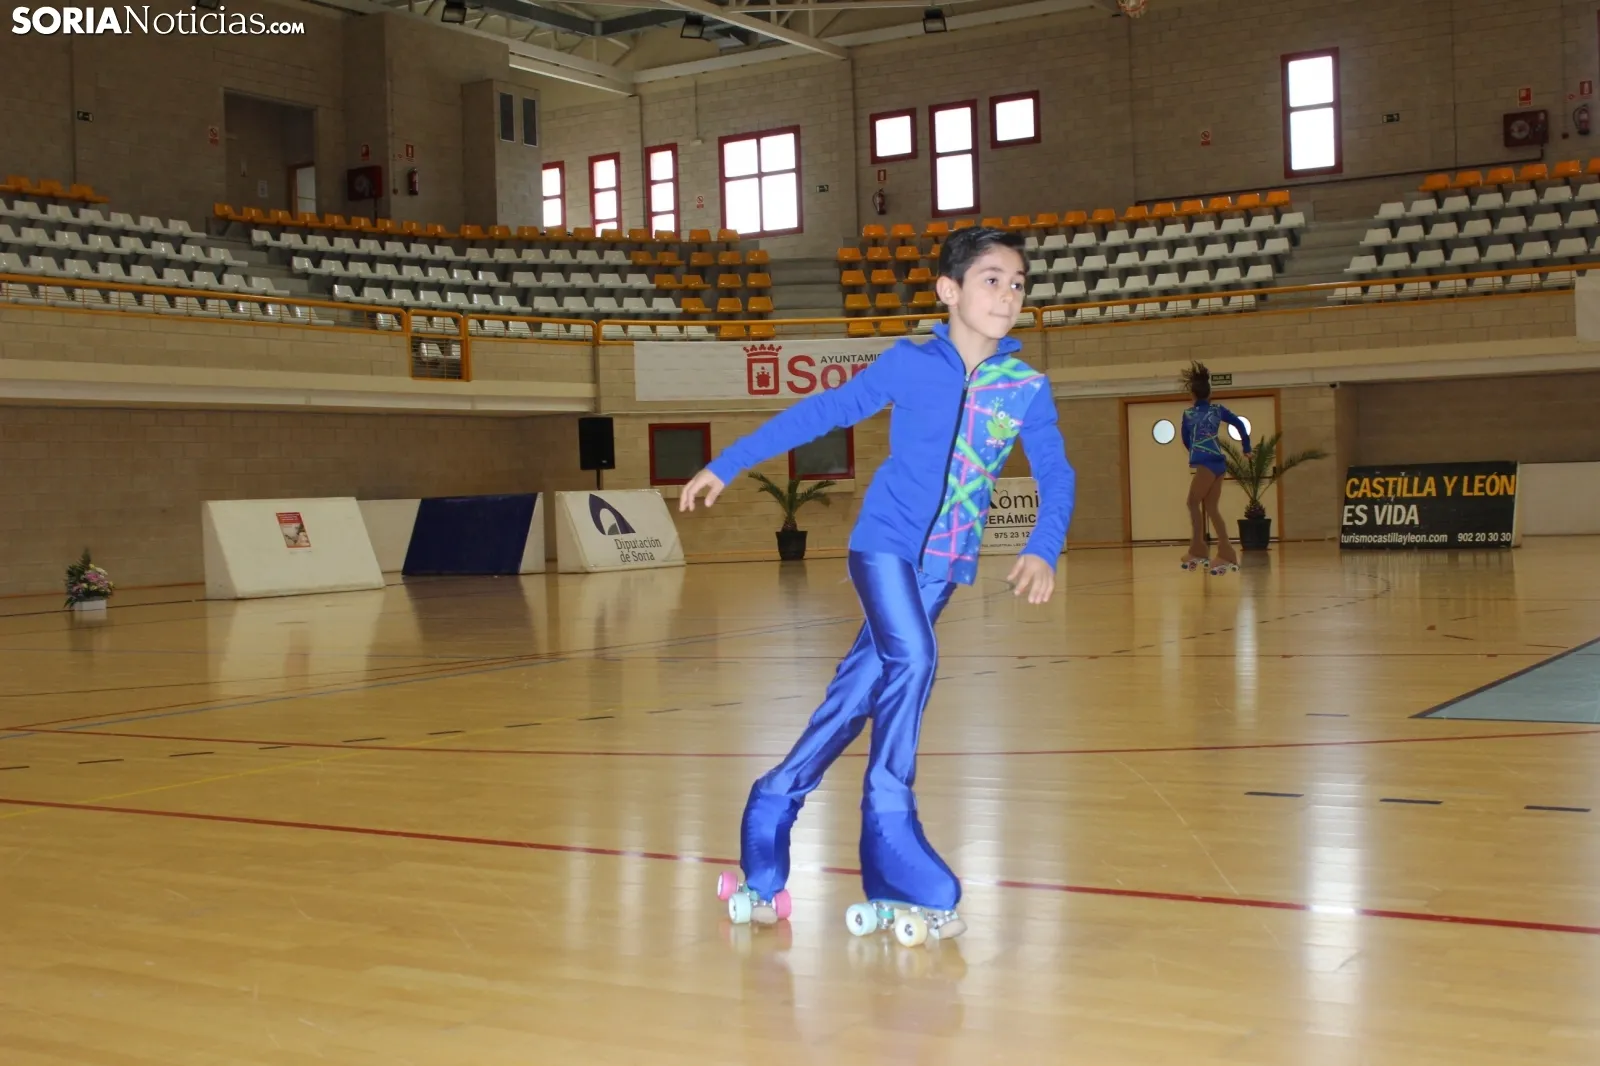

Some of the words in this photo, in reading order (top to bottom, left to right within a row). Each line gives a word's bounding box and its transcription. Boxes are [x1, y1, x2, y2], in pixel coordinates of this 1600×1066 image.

[1345, 476, 1437, 499] CASTILLA
[1443, 475, 1458, 497] Y
[1462, 471, 1516, 497] LEÓN
[1342, 504, 1368, 526] ES
[1374, 504, 1420, 526] VIDA
[1010, 531, 1019, 539] 23
[1341, 532, 1448, 546] turismocastillayleon.com
[1457, 532, 1473, 542] 902
[1475, 532, 1486, 542] 20
[1488, 532, 1499, 542] 30
[1500, 532, 1512, 542] 30
[614, 537, 662, 552] Diputación
[620, 551, 631, 563] de
[632, 550, 655, 562] Soria
